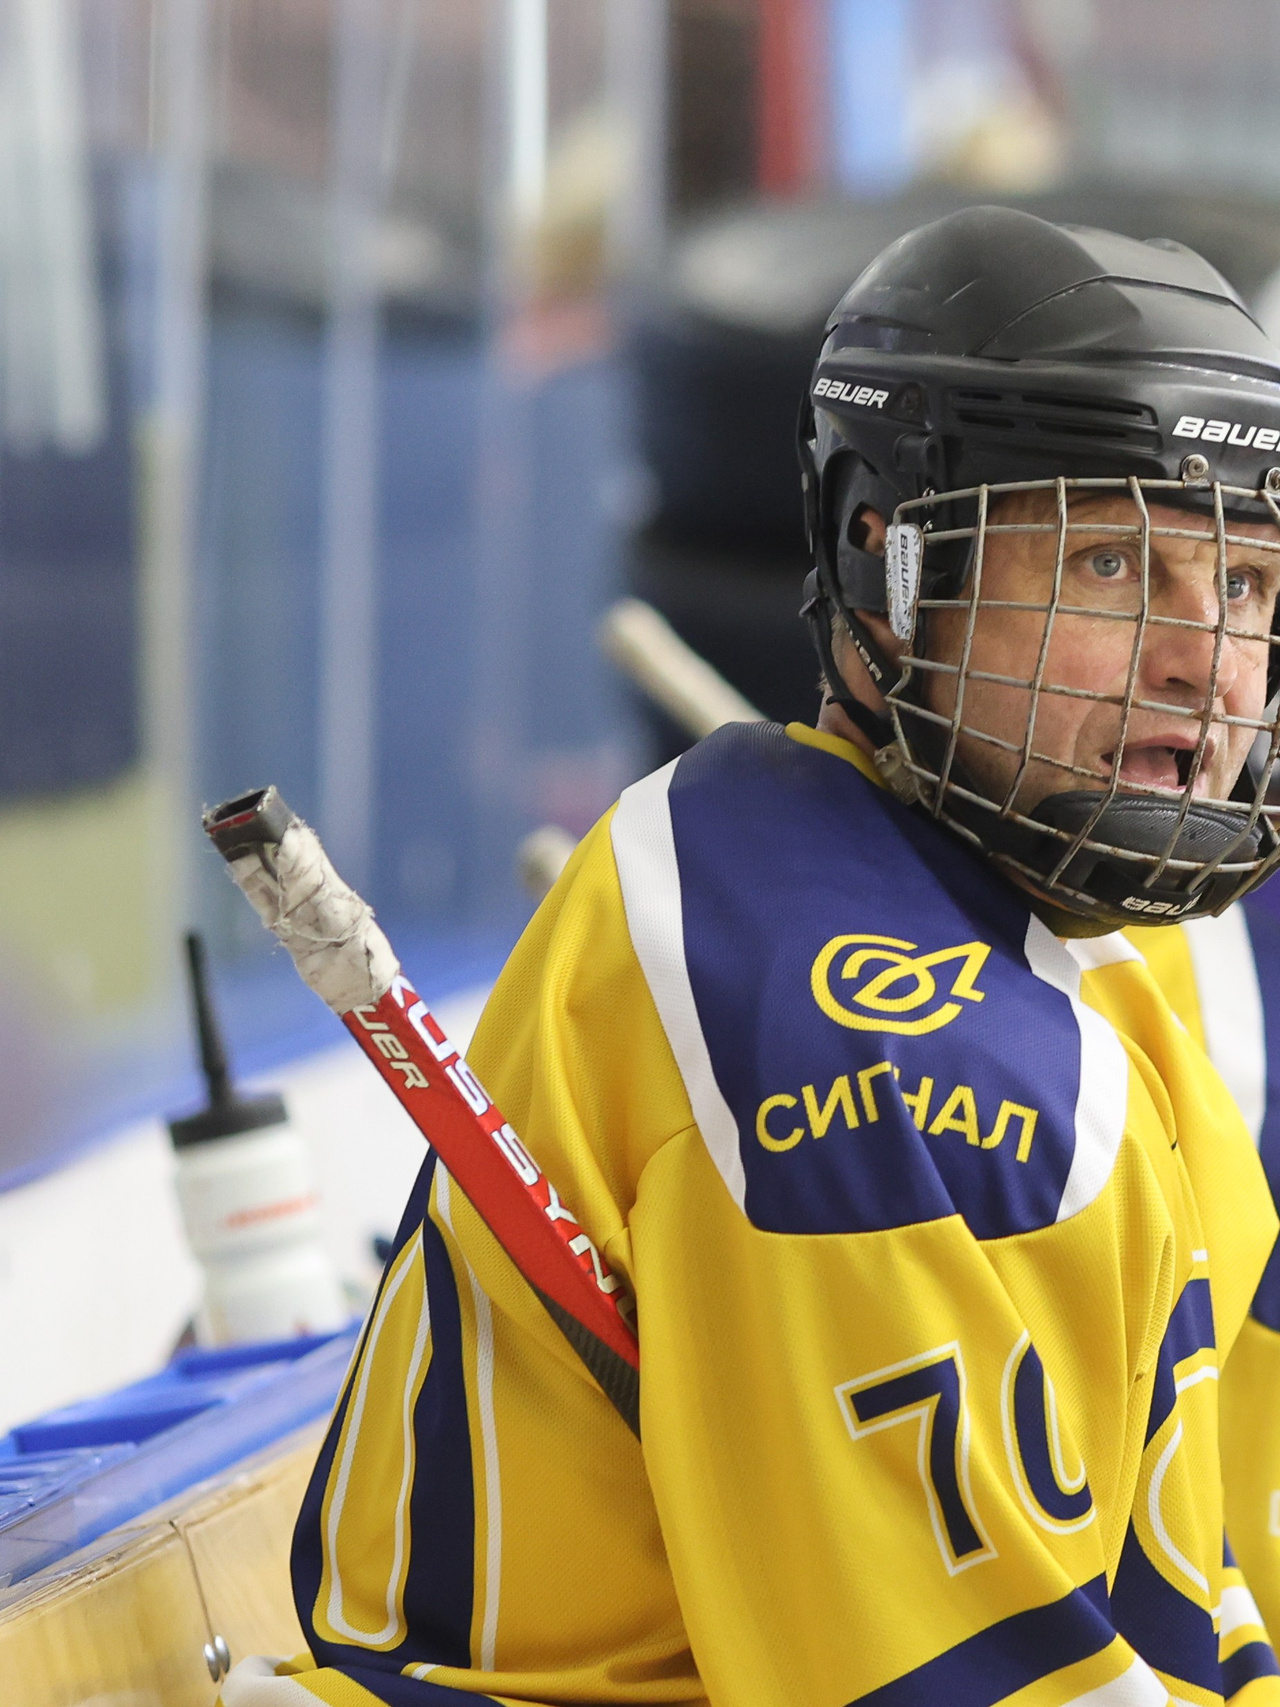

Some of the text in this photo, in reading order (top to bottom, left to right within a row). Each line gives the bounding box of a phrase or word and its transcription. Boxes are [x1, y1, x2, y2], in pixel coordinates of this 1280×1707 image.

[812, 377, 890, 409] BAUER
[352, 1004, 430, 1090] UER
[755, 1060, 1039, 1164] СИГНАЛ
[833, 1327, 1098, 1578] 70
